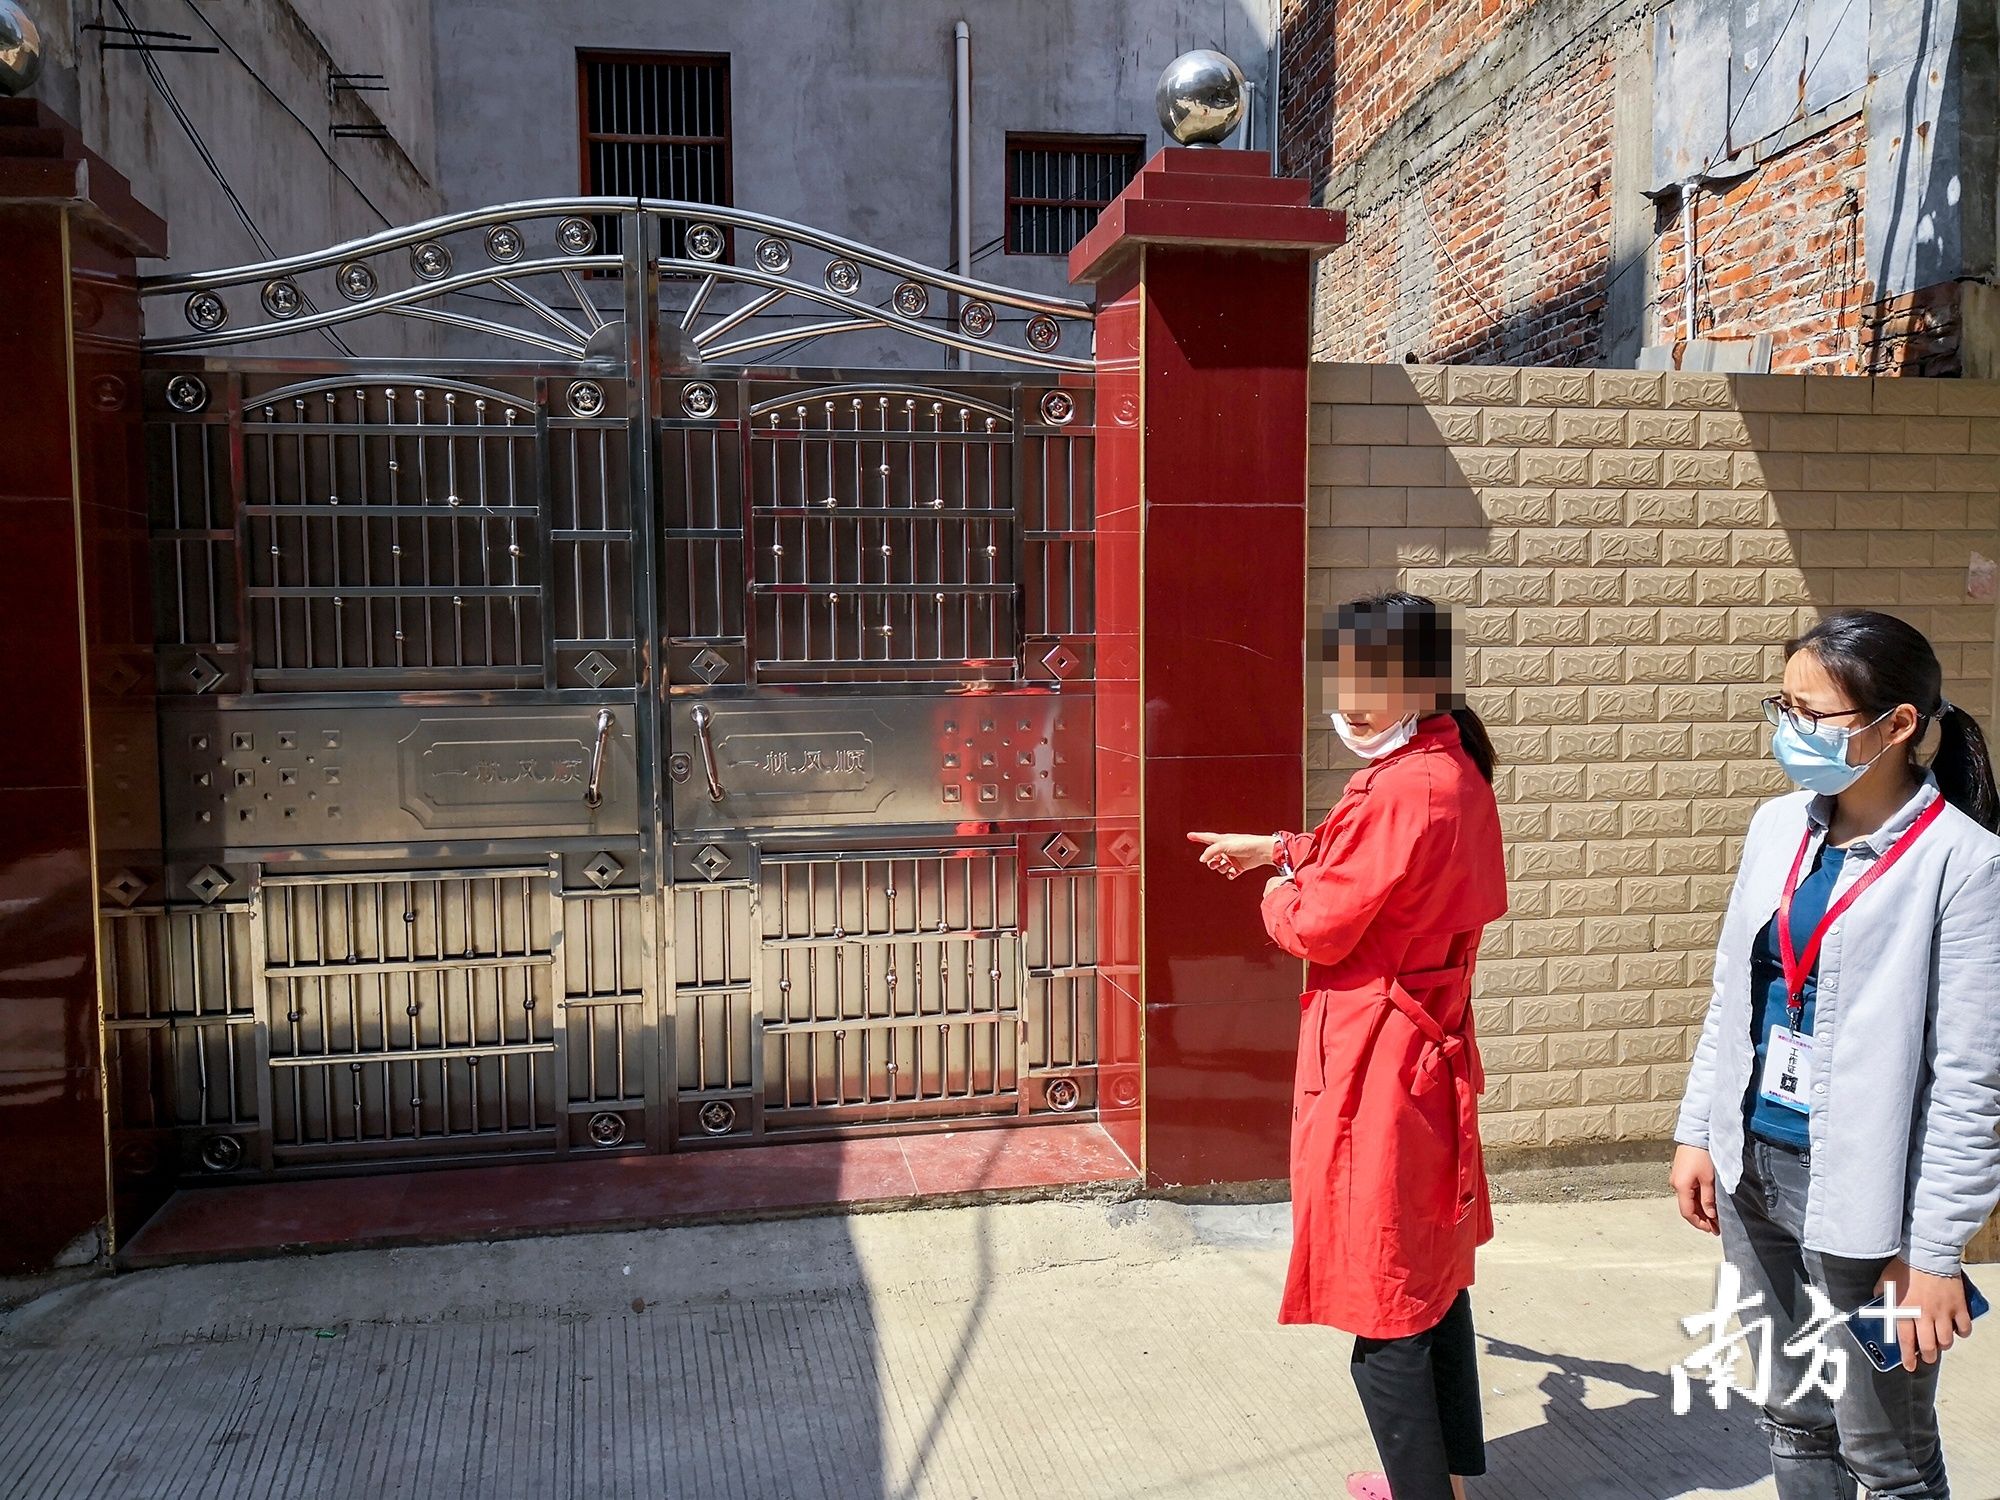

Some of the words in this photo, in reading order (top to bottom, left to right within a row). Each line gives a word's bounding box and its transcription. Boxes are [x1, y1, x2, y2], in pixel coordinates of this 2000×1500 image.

[432, 759, 583, 784] 一帆风顺
[728, 750, 865, 776] 一帆风顺
[1787, 1047, 1798, 1074] 工作证
